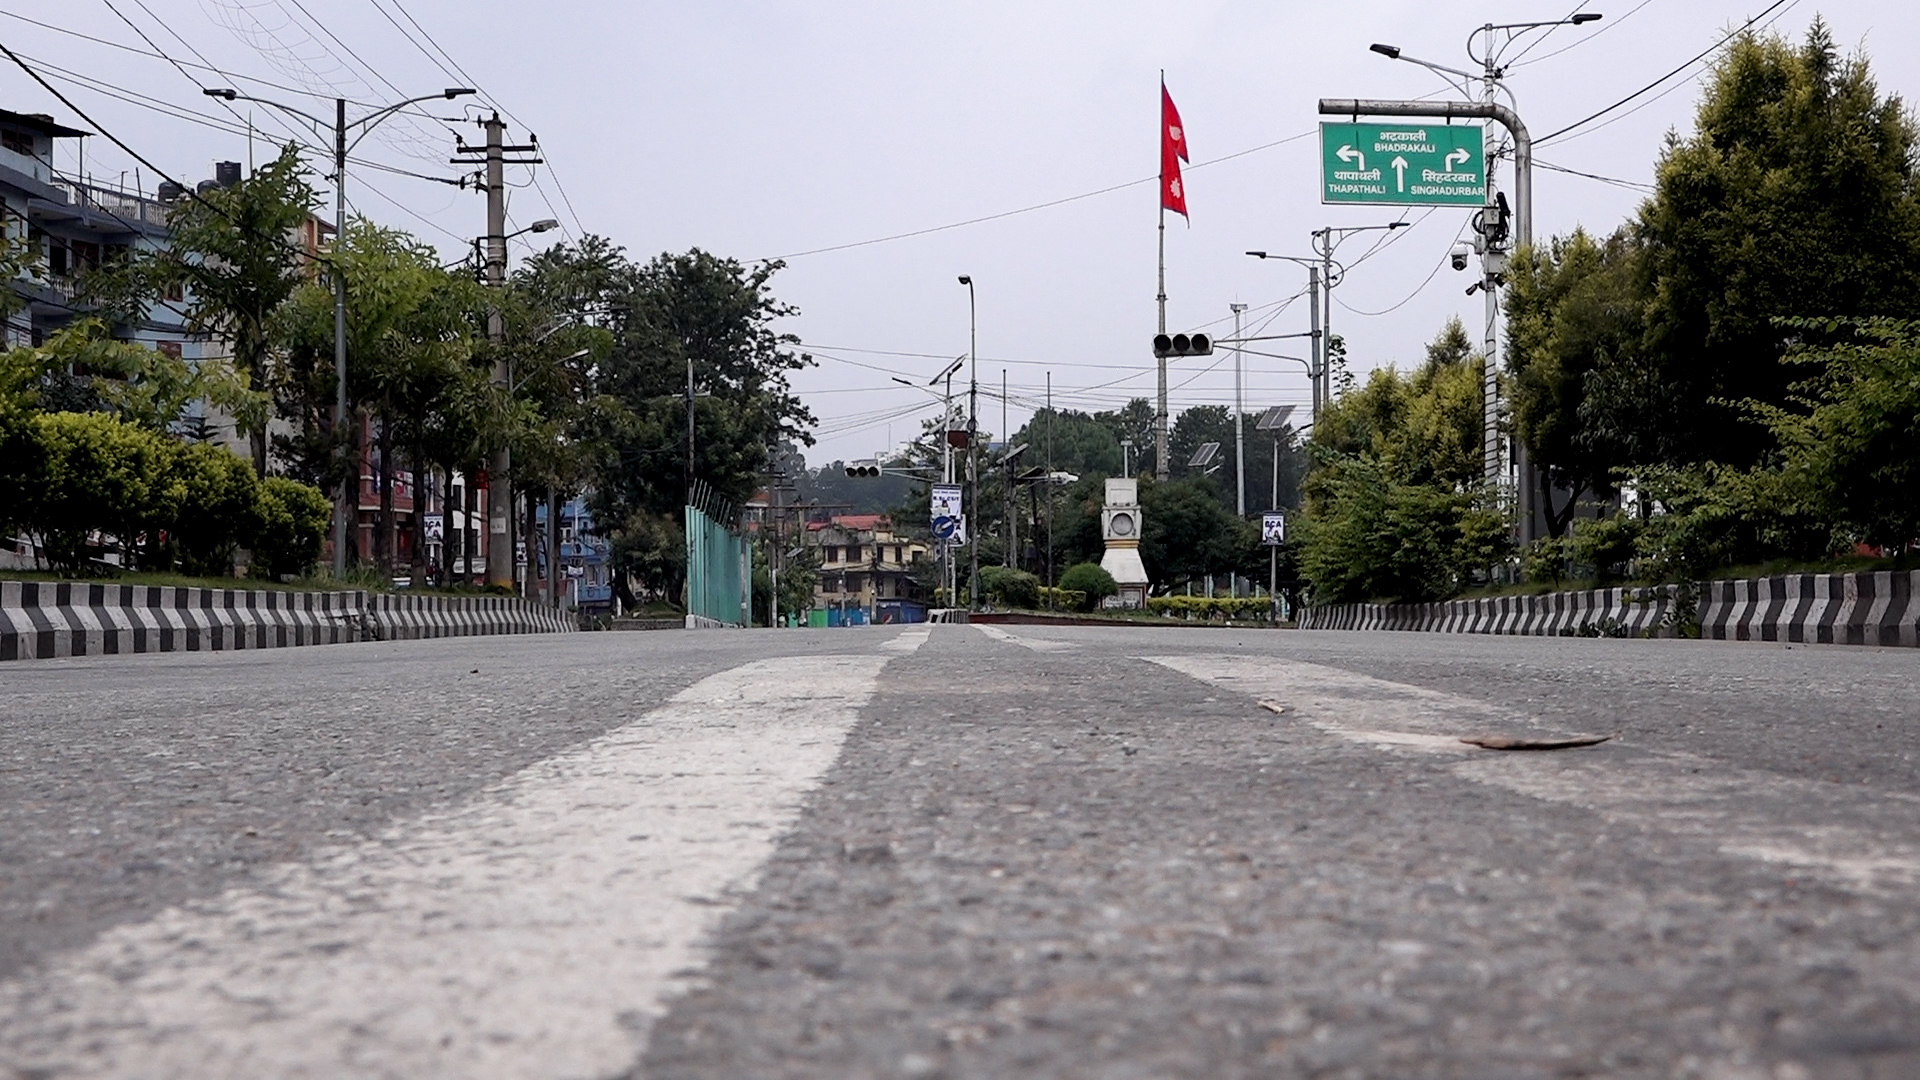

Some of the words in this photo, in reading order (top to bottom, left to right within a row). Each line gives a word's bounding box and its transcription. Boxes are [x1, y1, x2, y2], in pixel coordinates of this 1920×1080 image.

[1380, 130, 1426, 141] भद्रकाली
[1374, 143, 1436, 153] BHADRAKALI
[1334, 168, 1381, 181] थापाथली
[1328, 183, 1386, 194] THAPATHALI
[1410, 185, 1485, 196] SINGHADURBAR
